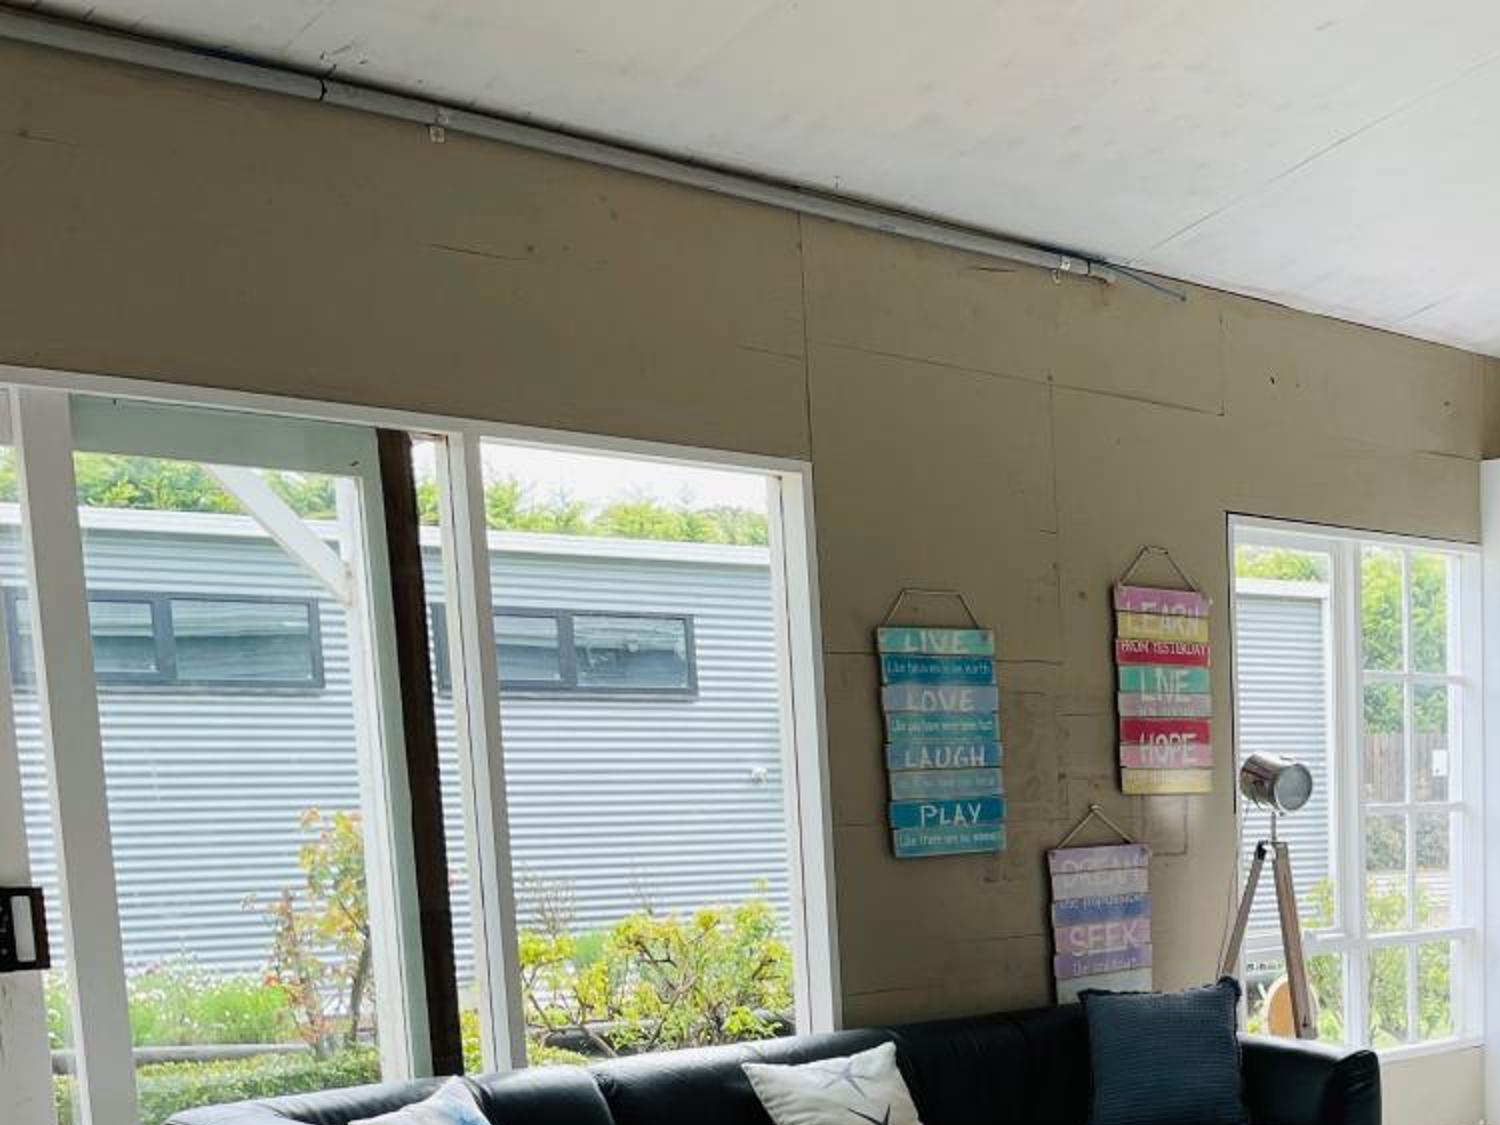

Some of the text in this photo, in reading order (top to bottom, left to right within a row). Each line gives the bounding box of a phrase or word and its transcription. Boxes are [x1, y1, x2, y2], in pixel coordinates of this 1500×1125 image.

[1126, 601, 1200, 637] LEARN
[904, 631, 971, 652] LIVE
[1141, 669, 1190, 701] LIVE
[906, 689, 976, 711] LOVE
[904, 747, 986, 769] LAUGH
[1140, 733, 1198, 765] HOPE
[919, 803, 983, 828] PLAY
[1069, 920, 1140, 957] SEEK
